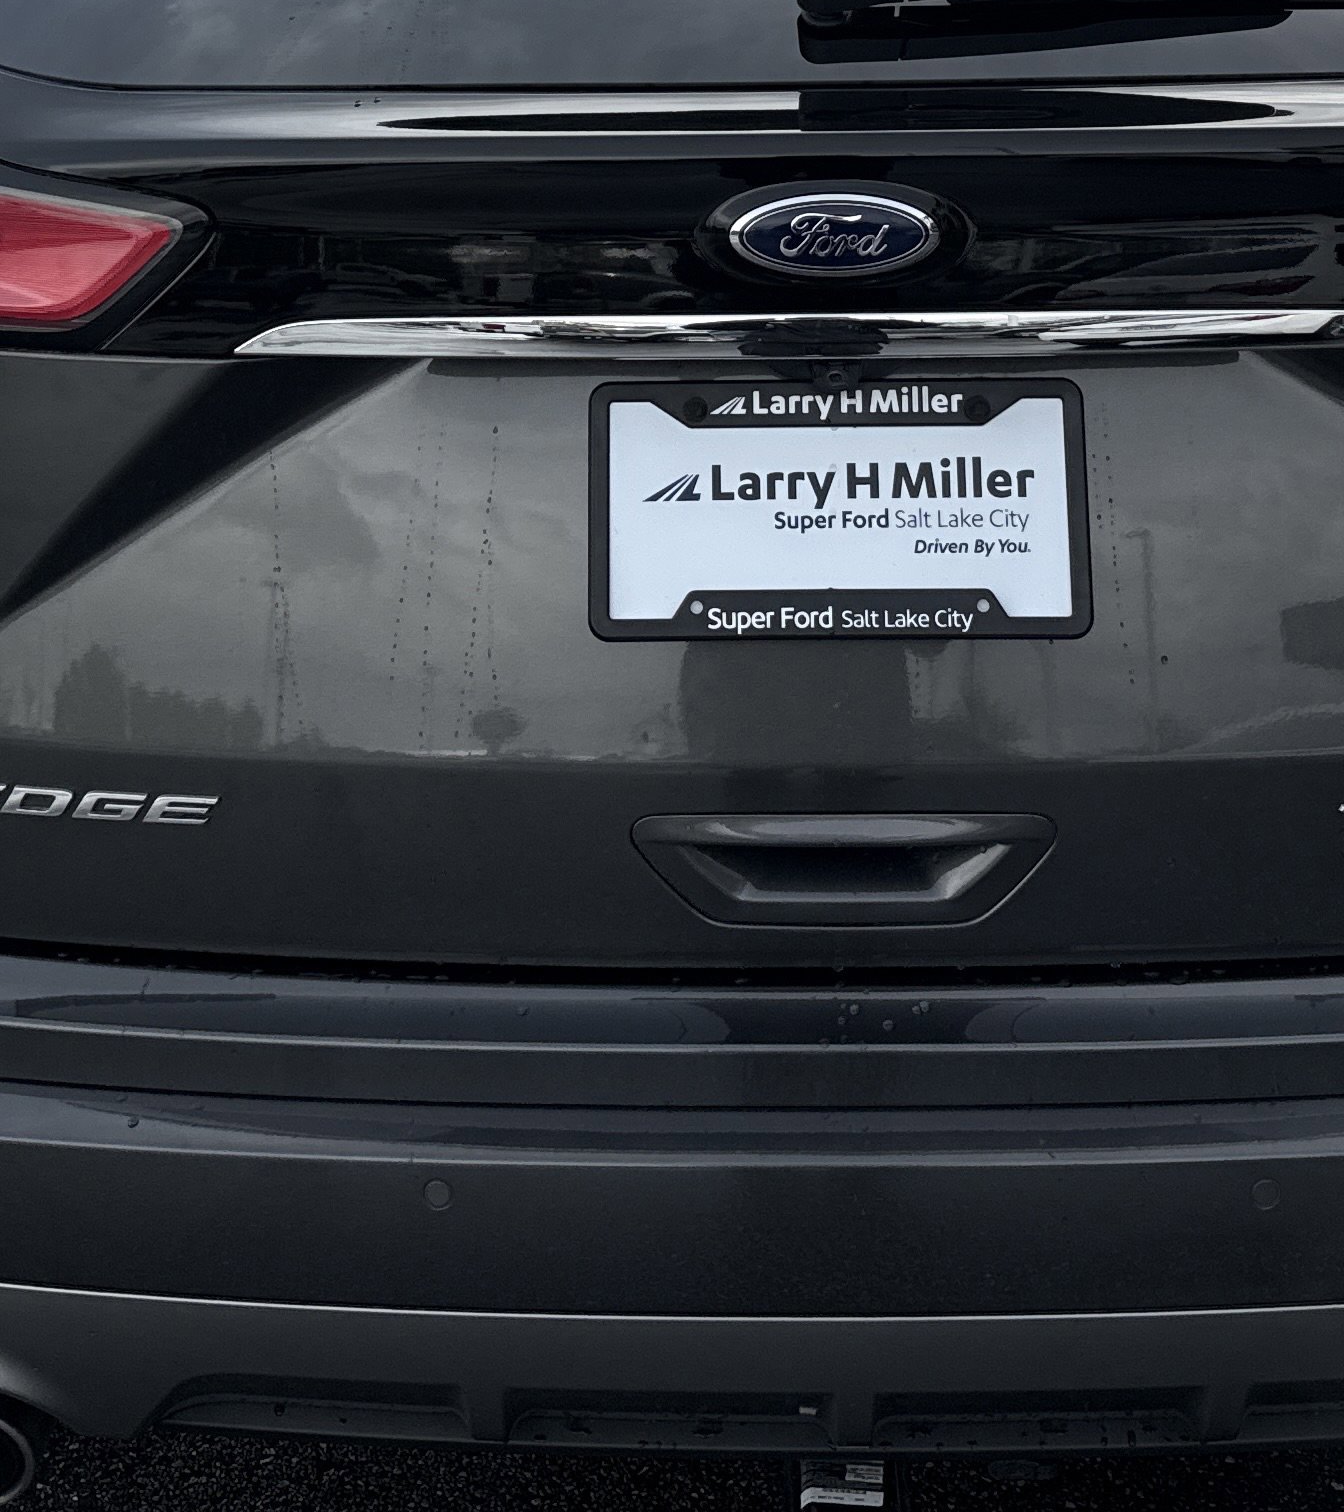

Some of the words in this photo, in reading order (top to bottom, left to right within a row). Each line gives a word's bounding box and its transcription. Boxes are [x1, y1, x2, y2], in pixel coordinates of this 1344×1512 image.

[779, 212, 890, 257] Ford
[752, 390, 834, 421] Larry
[840, 389, 863, 414] H
[869, 385, 964, 413] Miller
[711, 464, 837, 509] Larry
[846, 462, 880, 499] H
[891, 456, 1035, 499] Miller
[774, 510, 837, 534] Super
[842, 508, 889, 529] Ford
[895, 508, 932, 528] Salt
[938, 507, 984, 528] Lake
[989, 507, 1030, 533] City
[914, 538, 969, 555] Driven
[974, 539, 995, 557] By
[998, 538, 1032, 554] You.
[706, 607, 775, 635] Super
[780, 606, 833, 629] Ford
[841, 609, 880, 628] Salt
[884, 608, 930, 628] Lake
[934, 608, 974, 633] City
